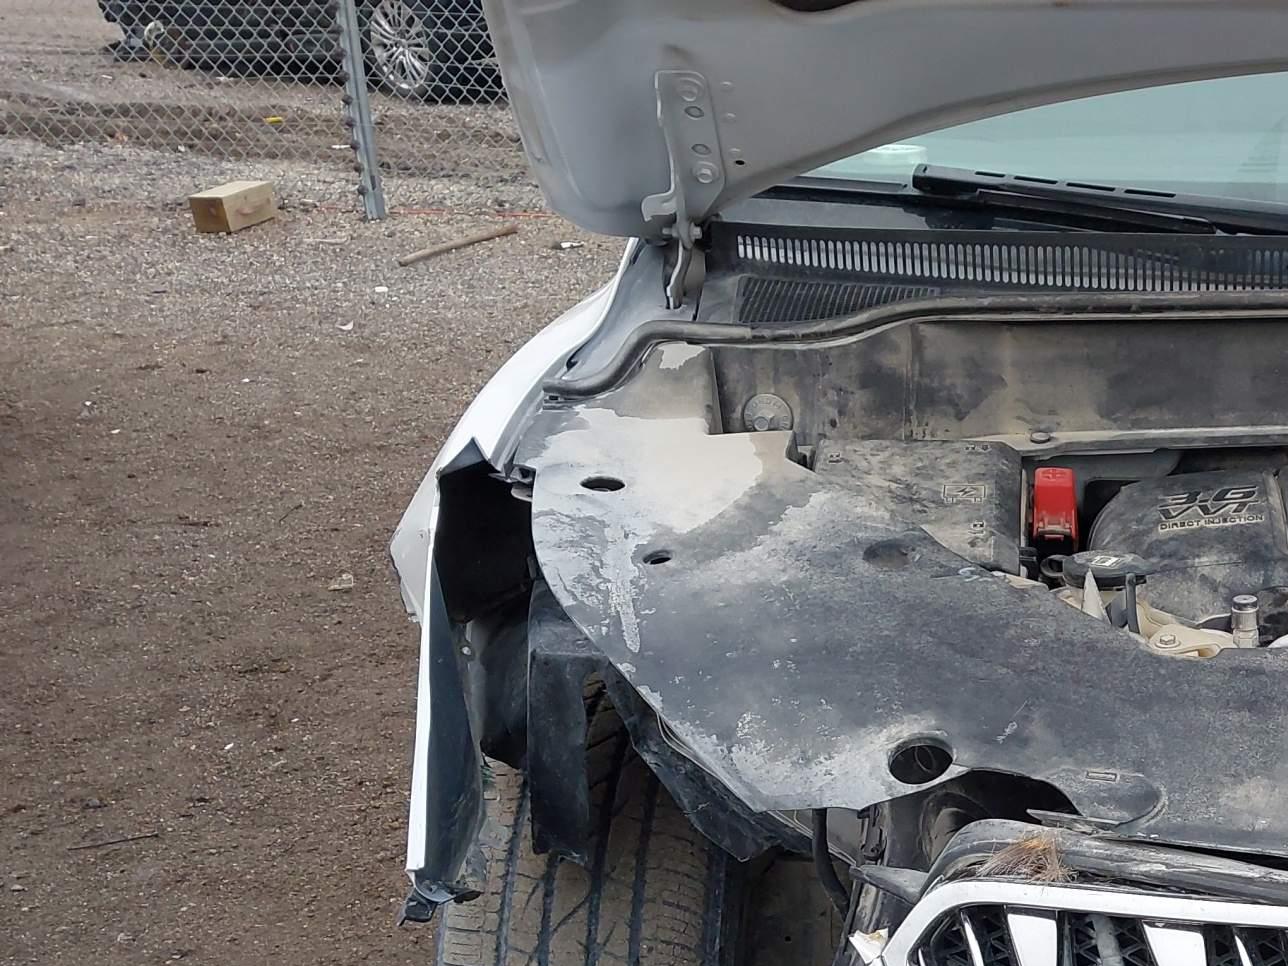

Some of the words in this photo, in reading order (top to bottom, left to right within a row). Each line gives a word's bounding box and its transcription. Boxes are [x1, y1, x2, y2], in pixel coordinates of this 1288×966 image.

[1159, 500, 1261, 520] VVT
[1159, 519, 1200, 531] DIRECT
[1204, 514, 1264, 526] INJECTION
